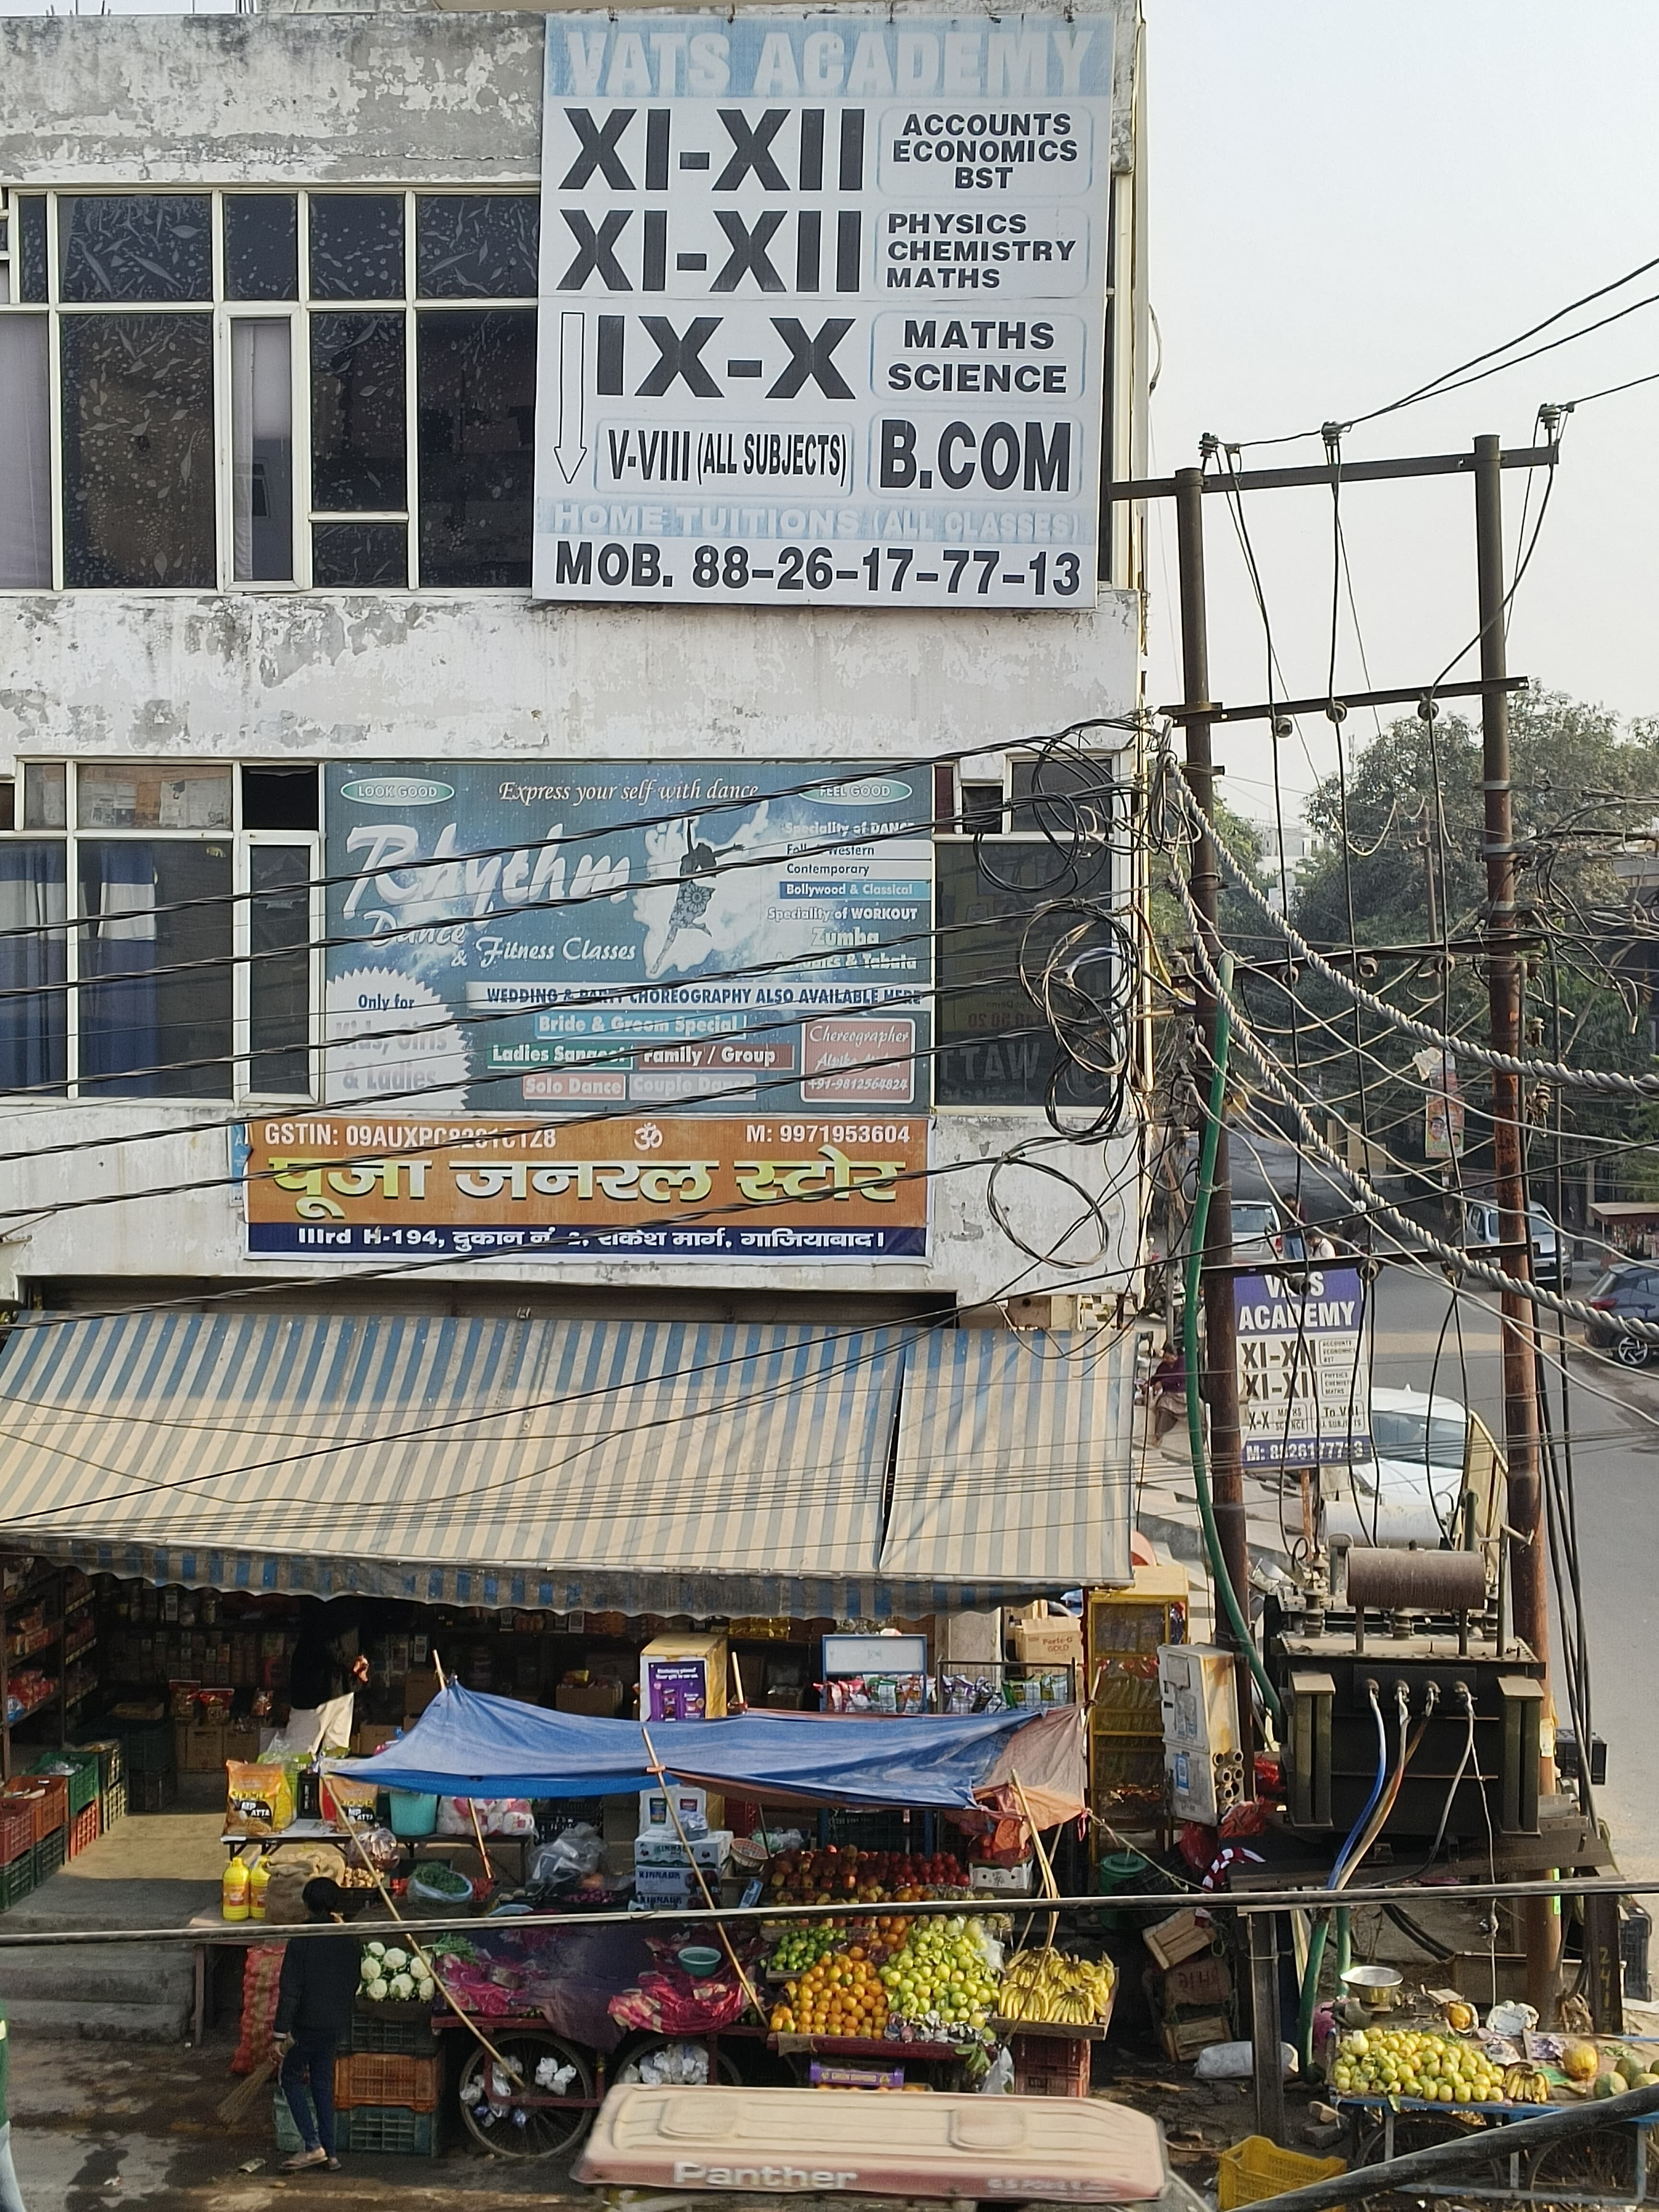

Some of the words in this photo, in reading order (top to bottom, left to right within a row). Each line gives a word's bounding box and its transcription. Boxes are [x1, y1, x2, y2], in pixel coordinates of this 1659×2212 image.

[565, 32, 730, 93] VATS
[754, 30, 1094, 93] ACADEMY
[902, 113, 1070, 136] ACCOUNTS
[558, 108, 865, 191] XI-XII
[892, 140, 1078, 162] ECONOMICS
[955, 166, 1013, 190] BST
[888, 213, 1026, 235] PHYSICS
[556, 210, 861, 293] XI-XII
[888, 240, 1077, 262] CHEMISTRY
[887, 266, 1000, 289] MATHS
[903, 319, 1055, 350] MATHS
[596, 314, 856, 399] IX-X
[888, 362, 1068, 394] SCIENCE
[608, 429, 691, 481] V-VIII
[697, 432, 738, 485] (ALL
[744, 433, 847, 487] SUBJECTS)
[879, 419, 1071, 492] B.COM
[554, 503, 666, 534] HOME
[680, 504, 860, 537] TUITIONS
[872, 508, 933, 537] (ALL
[945, 510, 1079, 540] CLASSES)
[555, 540, 673, 588] MOB.
[692, 546, 1082, 596] 88-26-17-77-13
[357, 785, 394, 798] LOOK
[397, 785, 438, 799] GOOD
[498, 781, 570, 806] Express
[574, 784, 617, 806] your
[621, 778, 657, 806] self
[658, 779, 701, 800] with
[707, 778, 759, 800] dance
[819, 785, 847, 797] FEEL
[850, 785, 891, 797] GOOD
[784, 820, 850, 837] Speciality
[854, 821, 867, 834] of
[870, 822, 915, 834] DANC
[342, 822, 630, 930] Rhythm
[787, 864, 869, 877] Contemporary
[786, 883, 846, 898] Bollywood
[850, 885, 858, 895] &
[863, 884, 913, 895] Classical
[768, 907, 830, 923] Speciality
[834, 907, 848, 920] of
[851, 907, 918, 920] WORKOUT
[811, 926, 880, 946] Zumba
[450, 950, 468, 968] &
[562, 937, 636, 961] Classes
[862, 951, 917, 970] Tabata
[358, 993, 390, 1012] Only
[394, 993, 415, 1010] for
[487, 987, 558, 1003] WEDDING
[630, 988, 752, 1004] CHOREOGRAPHY
[755, 988, 794, 1003] ALSO
[799, 988, 879, 1004] AVAILABLE
[539, 1014, 586, 1032] Bride
[591, 1015, 605, 1033] &
[611, 1014, 674, 1033] Groom
[675, 1013, 738, 1035] Special
[493, 1044, 553, 1062] Ladies
[721, 1046, 776, 1067] Group
[524, 1076, 564, 1094] Solo
[568, 1077, 623, 1095] Dance
[634, 1076, 691, 1096] Couple
[264, 1122, 339, 1146] GSTIN:
[746, 1124, 772, 1143] M:
[780, 1124, 910, 1144] 9971953604
[268, 1157, 432, 1220] पूजा
[449, 1159, 720, 1203] जनरल
[734, 1144, 906, 1202] स्टोर
[363, 1227, 445, 1249] H-194,
[452, 1230, 526, 1252] दुकान
[1264, 1271, 1324, 1298] VS
[1238, 1300, 1356, 1331] ACADEMY
[1277, 1407, 1301, 1418] MAHS
[1246, 1445, 1265, 1462] M:
[1270, 1440, 1363, 1460] 882617773
[251, 1809, 271, 1817] ATTA
[640, 1895, 683, 1905] INNAUR
[672, 2161, 858, 2190] Panther
